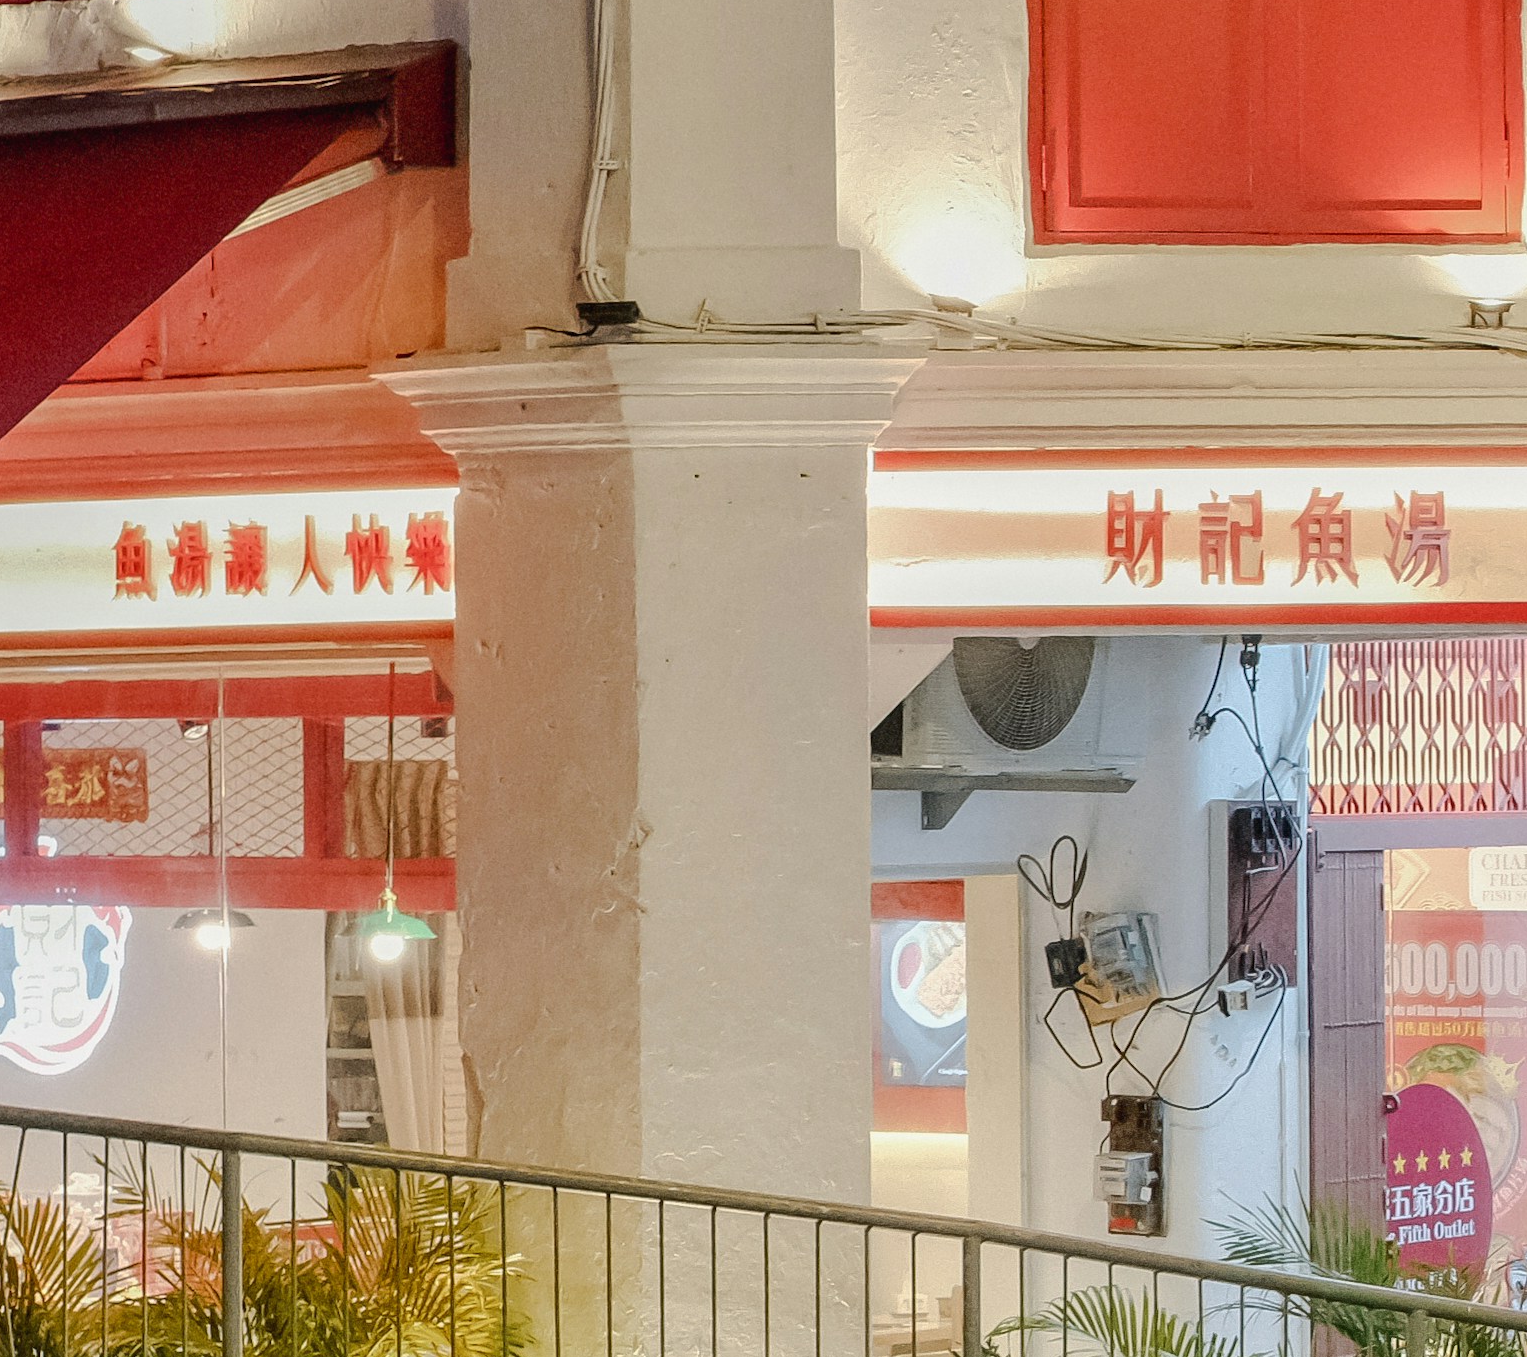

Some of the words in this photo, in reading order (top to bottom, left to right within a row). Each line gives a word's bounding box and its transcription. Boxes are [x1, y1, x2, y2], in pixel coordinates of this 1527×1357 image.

[1100, 488, 1451, 589] 財記魚湯
[1482, 890, 1512, 902] FISH
[1397, 1222, 1432, 1246] Fifth
[1434, 1218, 1475, 1241] Outlet
